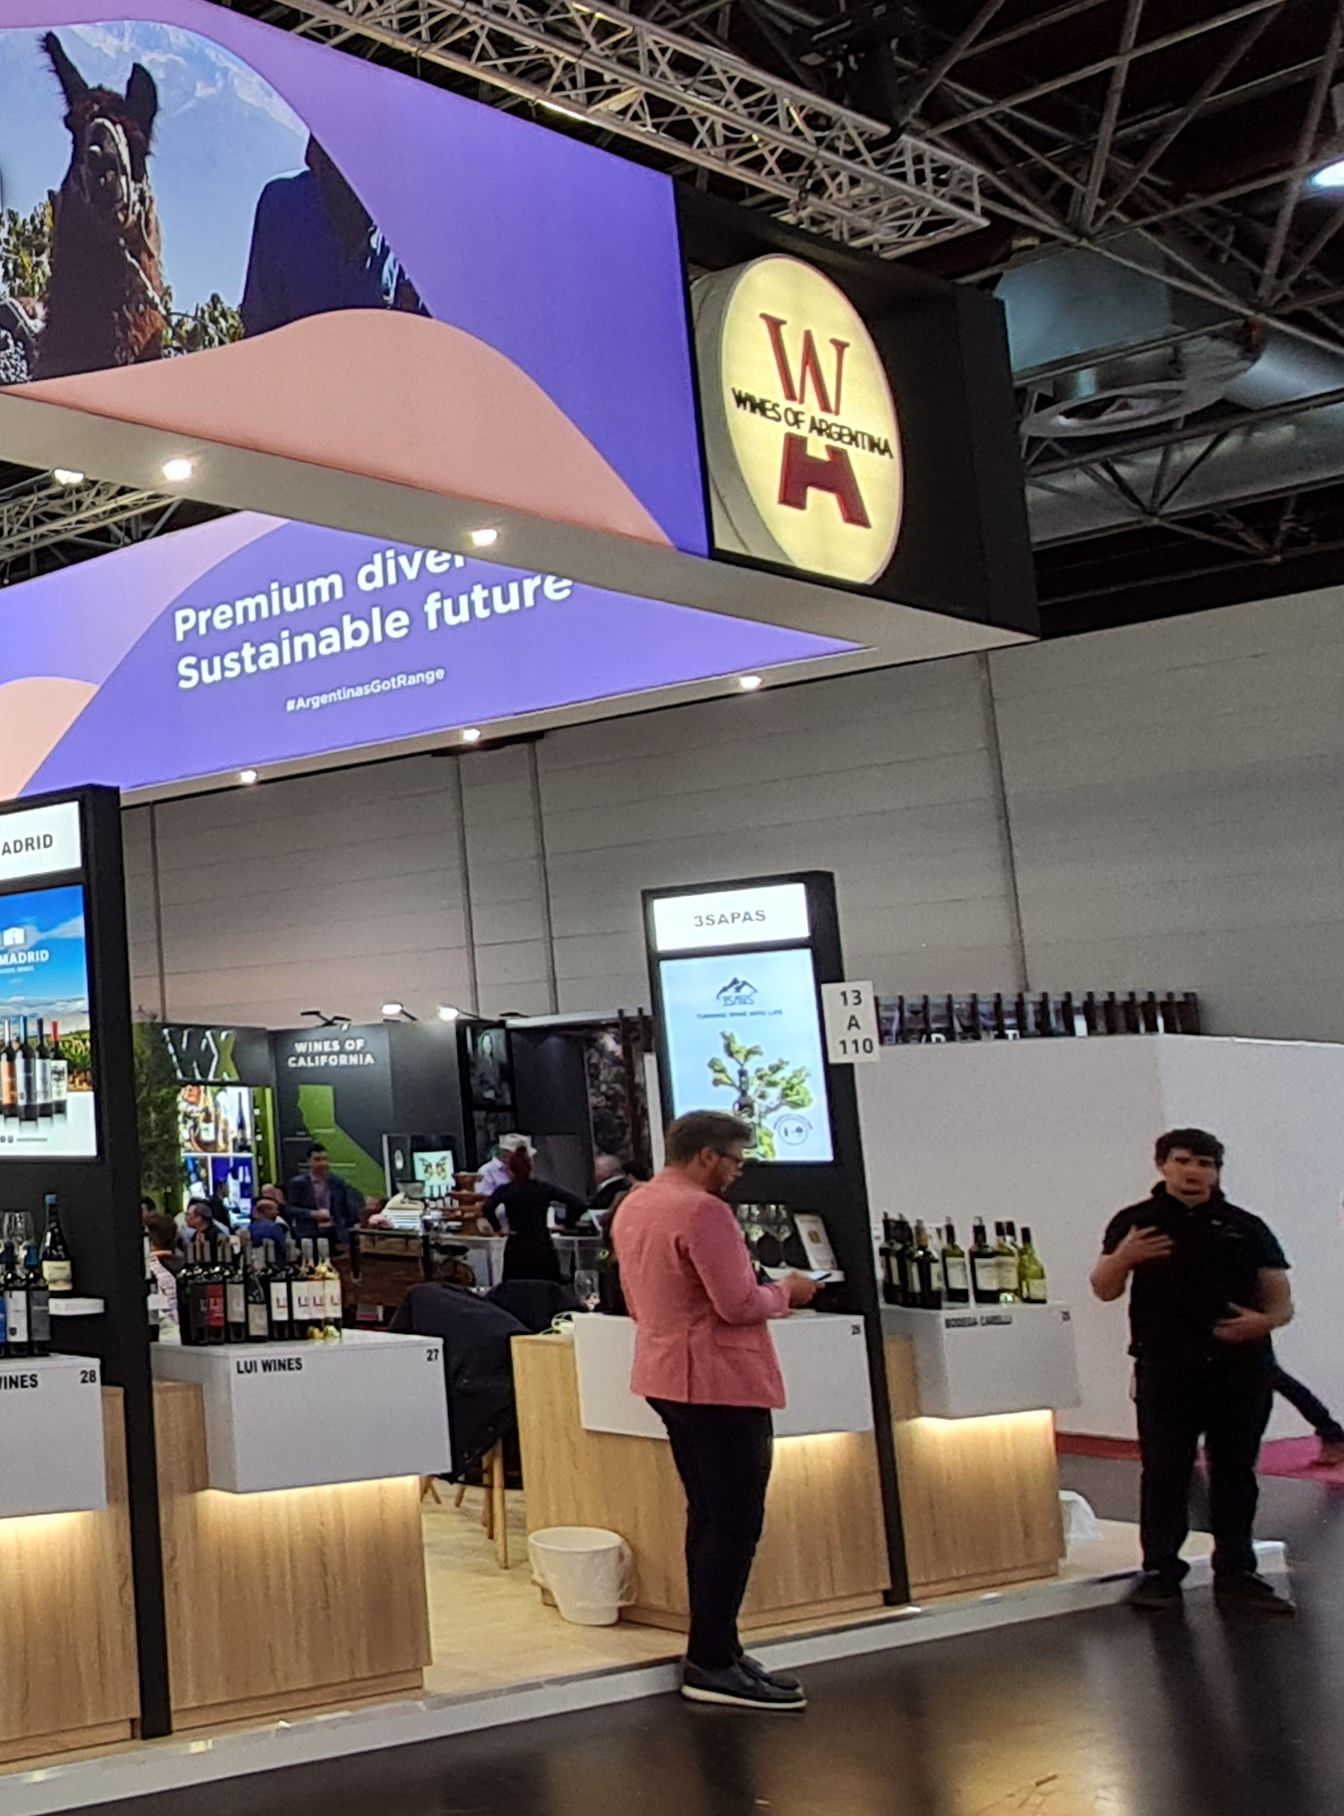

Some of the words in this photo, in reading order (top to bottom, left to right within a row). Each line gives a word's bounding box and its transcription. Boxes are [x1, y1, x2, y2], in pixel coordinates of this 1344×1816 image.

[731, 387, 782, 422] WINES
[783, 407, 805, 429] OF
[808, 416, 894, 459] ARGENTINA
[174, 571, 344, 642] Premium
[177, 606, 410, 690] Sustainable
[423, 575, 573, 631] future
[285, 667, 446, 713] #ArgentinasGotRange
[694, 909, 767, 928] 3SAPAS
[840, 989, 863, 1007] 13
[847, 1014, 861, 1031] A
[294, 1039, 341, 1053] WINES
[346, 1038, 365, 1050] OF
[839, 1037, 874, 1055] 110
[288, 1053, 375, 1068] CALIFORNIA
[426, 1348, 439, 1362] 27
[236, 1360, 258, 1374] LUI
[262, 1357, 303, 1372] WINES
[80, 1369, 97, 1384] 28
